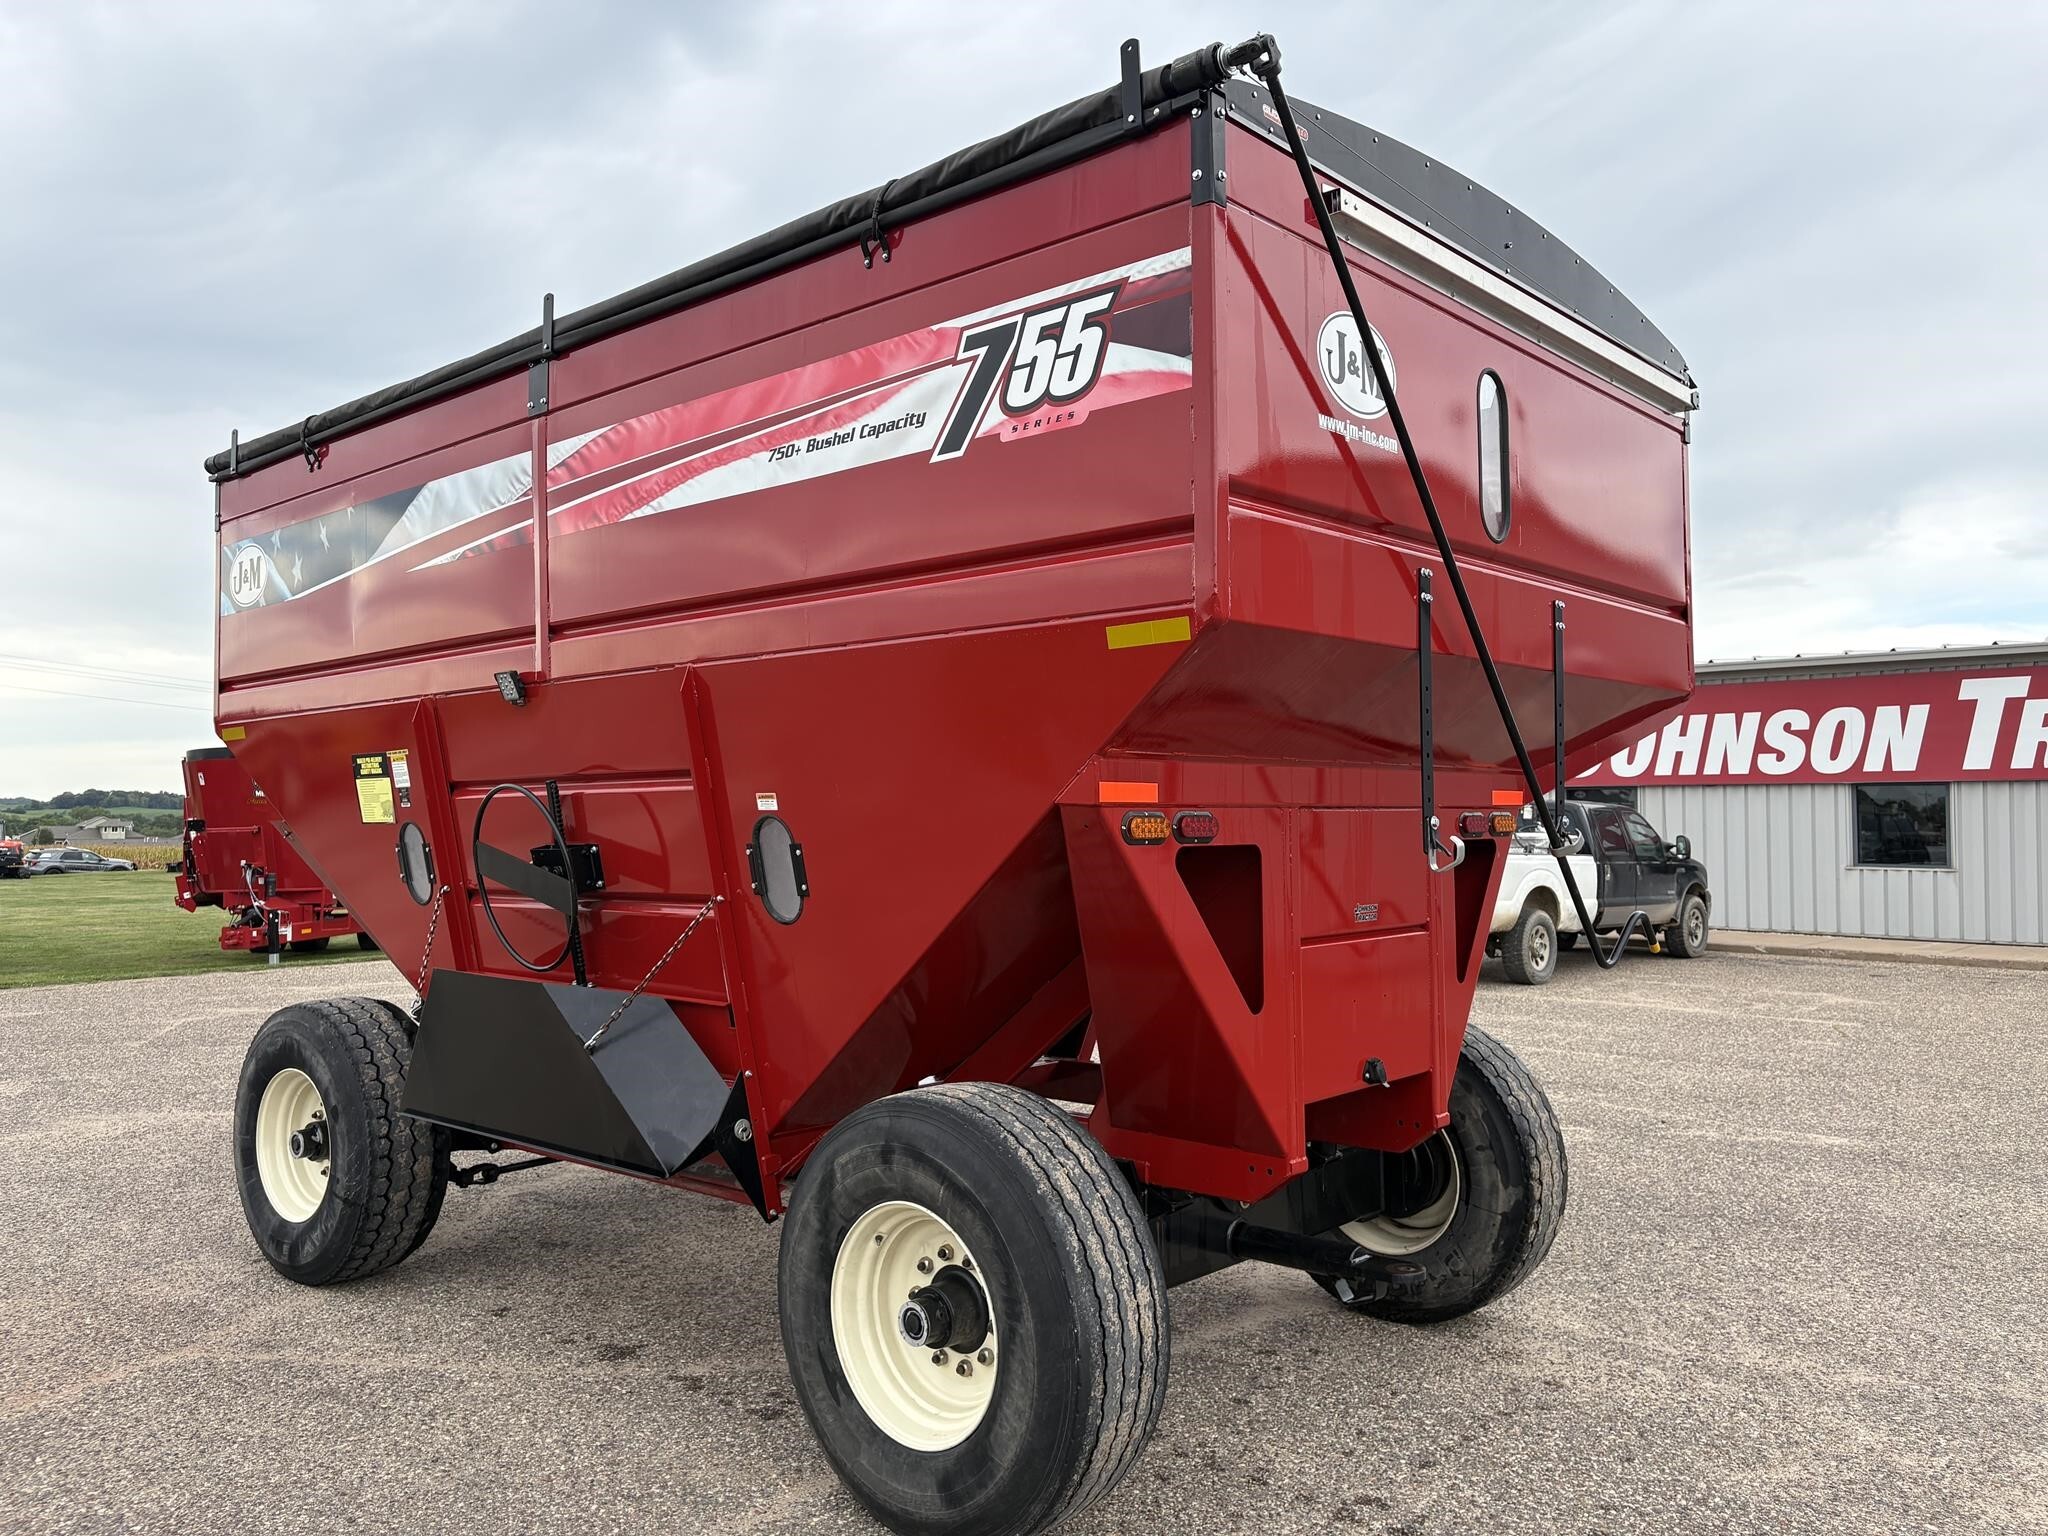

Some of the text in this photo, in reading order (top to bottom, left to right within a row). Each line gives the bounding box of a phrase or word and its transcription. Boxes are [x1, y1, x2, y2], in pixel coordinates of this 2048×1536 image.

[930, 283, 1122, 464] 755
[1326, 330, 1384, 401] J&M
[768, 411, 927, 463] 750+ Bushel Capacity
[1011, 411, 1075, 434] SERIES
[1318, 413, 1399, 454] www.jm-inc.com
[233, 555, 261, 595] J&M
[1575, 704, 1931, 779] OHNSON
